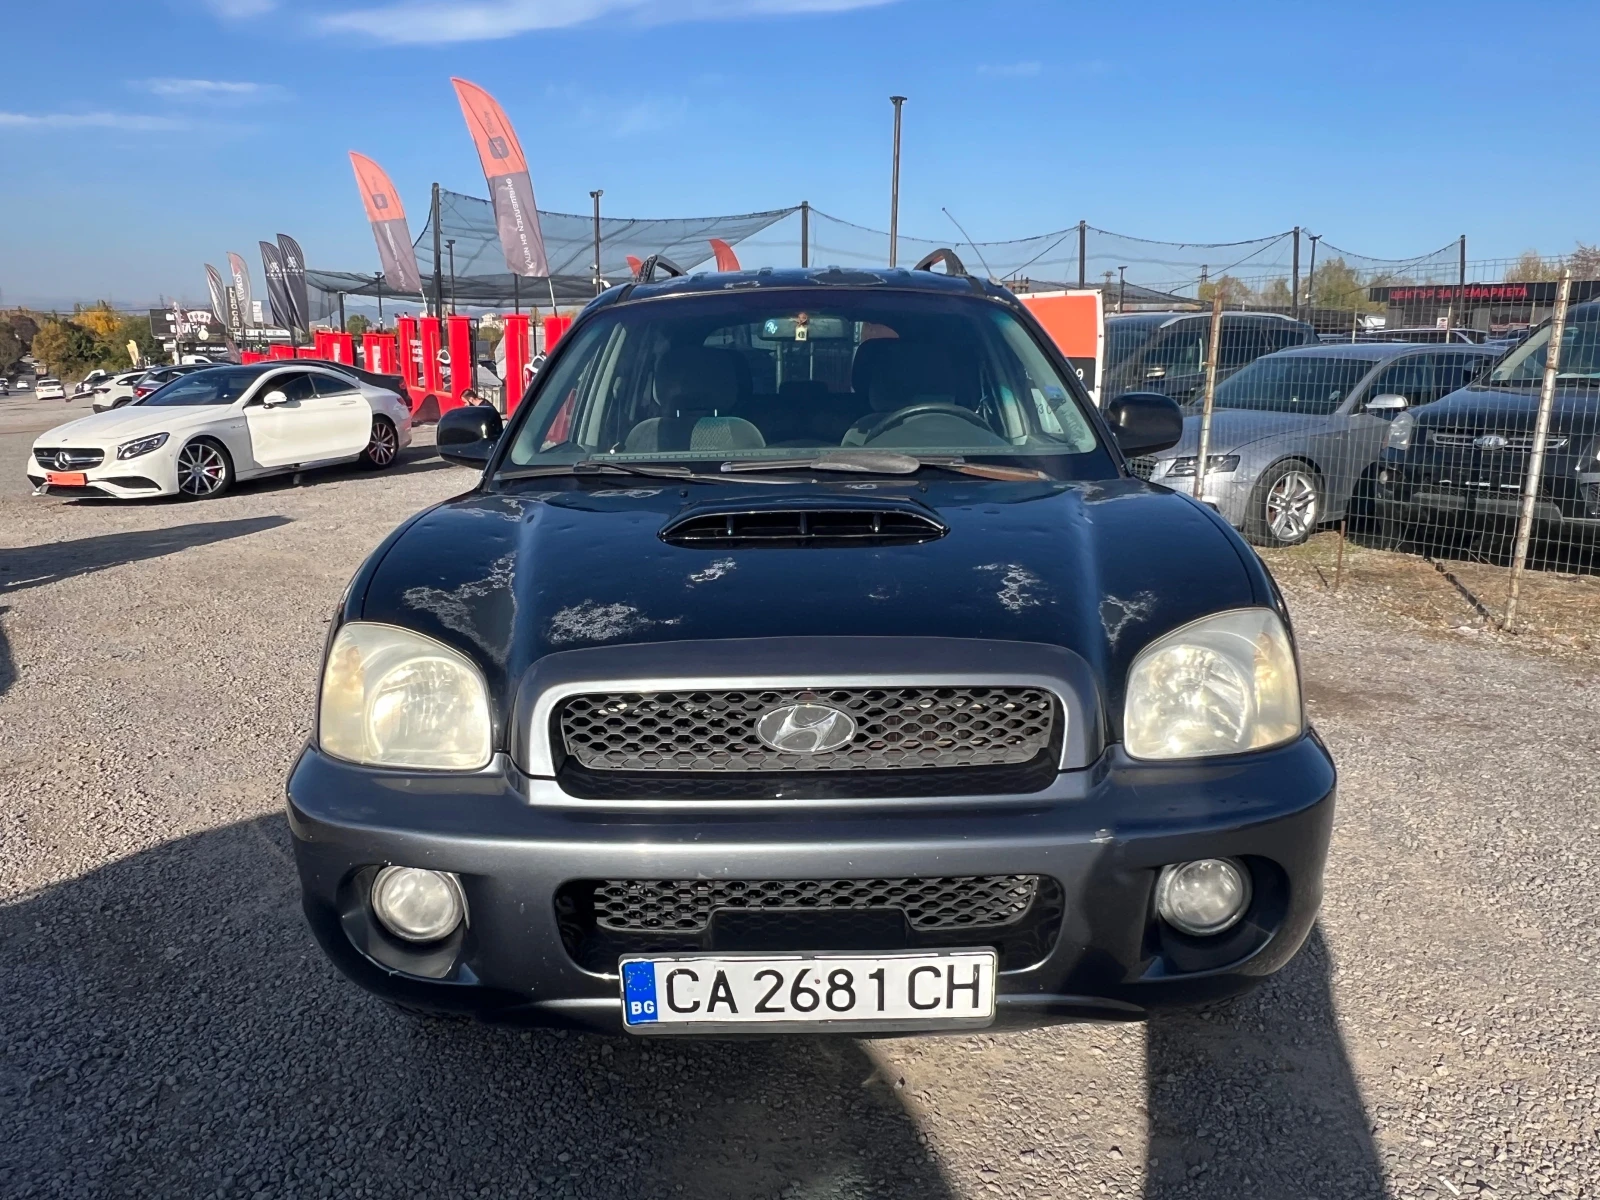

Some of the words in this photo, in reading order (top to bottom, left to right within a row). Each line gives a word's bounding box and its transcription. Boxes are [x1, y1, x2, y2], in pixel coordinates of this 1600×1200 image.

[1390, 290, 1433, 299] ЦЕНТЪР
[1437, 289, 1451, 298] ЗА
[1455, 287, 1527, 298] РЕМАРКЕТА
[231, 311, 240, 327] CAR
[666, 968, 739, 1014] CA
[753, 968, 888, 1013] 2681
[907, 963, 981, 1010] CH
[630, 1000, 655, 1015] BG
